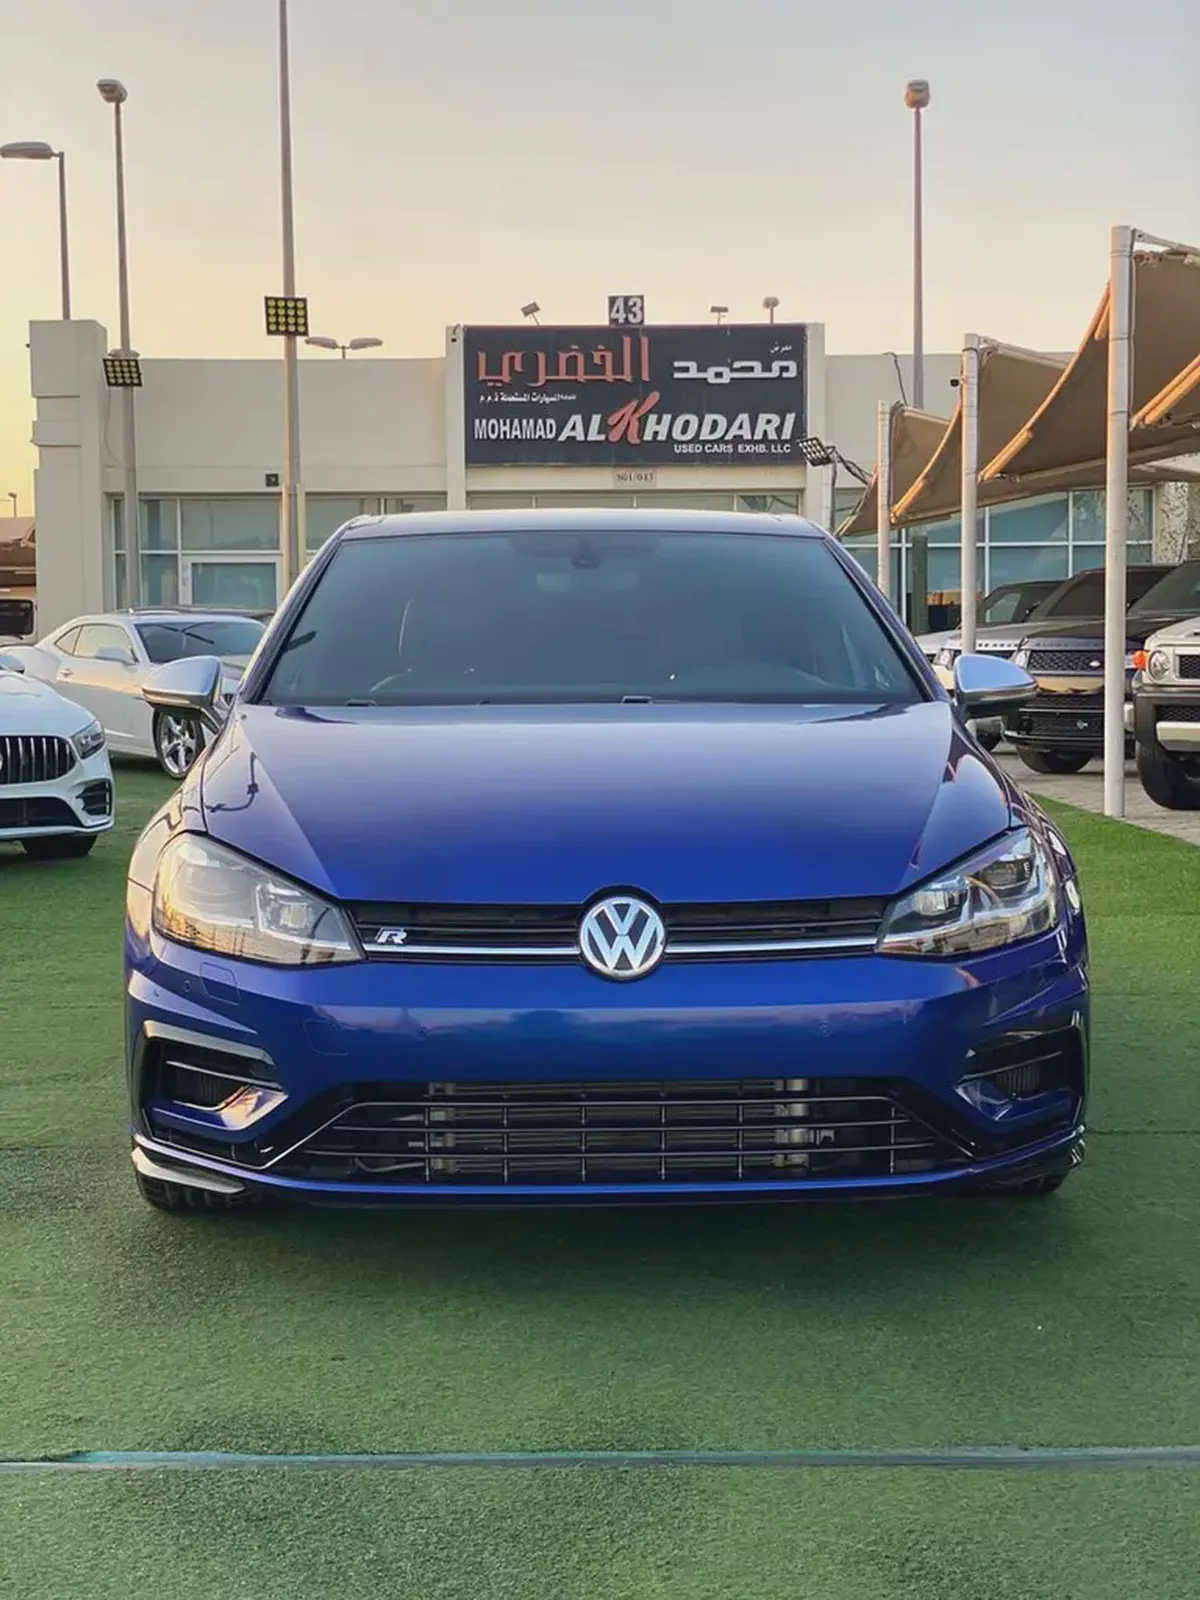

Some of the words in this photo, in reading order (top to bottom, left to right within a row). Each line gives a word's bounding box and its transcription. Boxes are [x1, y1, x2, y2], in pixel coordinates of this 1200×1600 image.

[610, 297, 643, 324] 43
[477, 335, 650, 387] الخضري
[673, 360, 797, 384] محمد
[474, 418, 557, 440] MOHAMAD
[673, 443, 703, 453] USED
[704, 443, 734, 453] CARS
[737, 443, 769, 453] EXHB.
[771, 443, 792, 453] LLC
[376, 927, 408, 944] R
